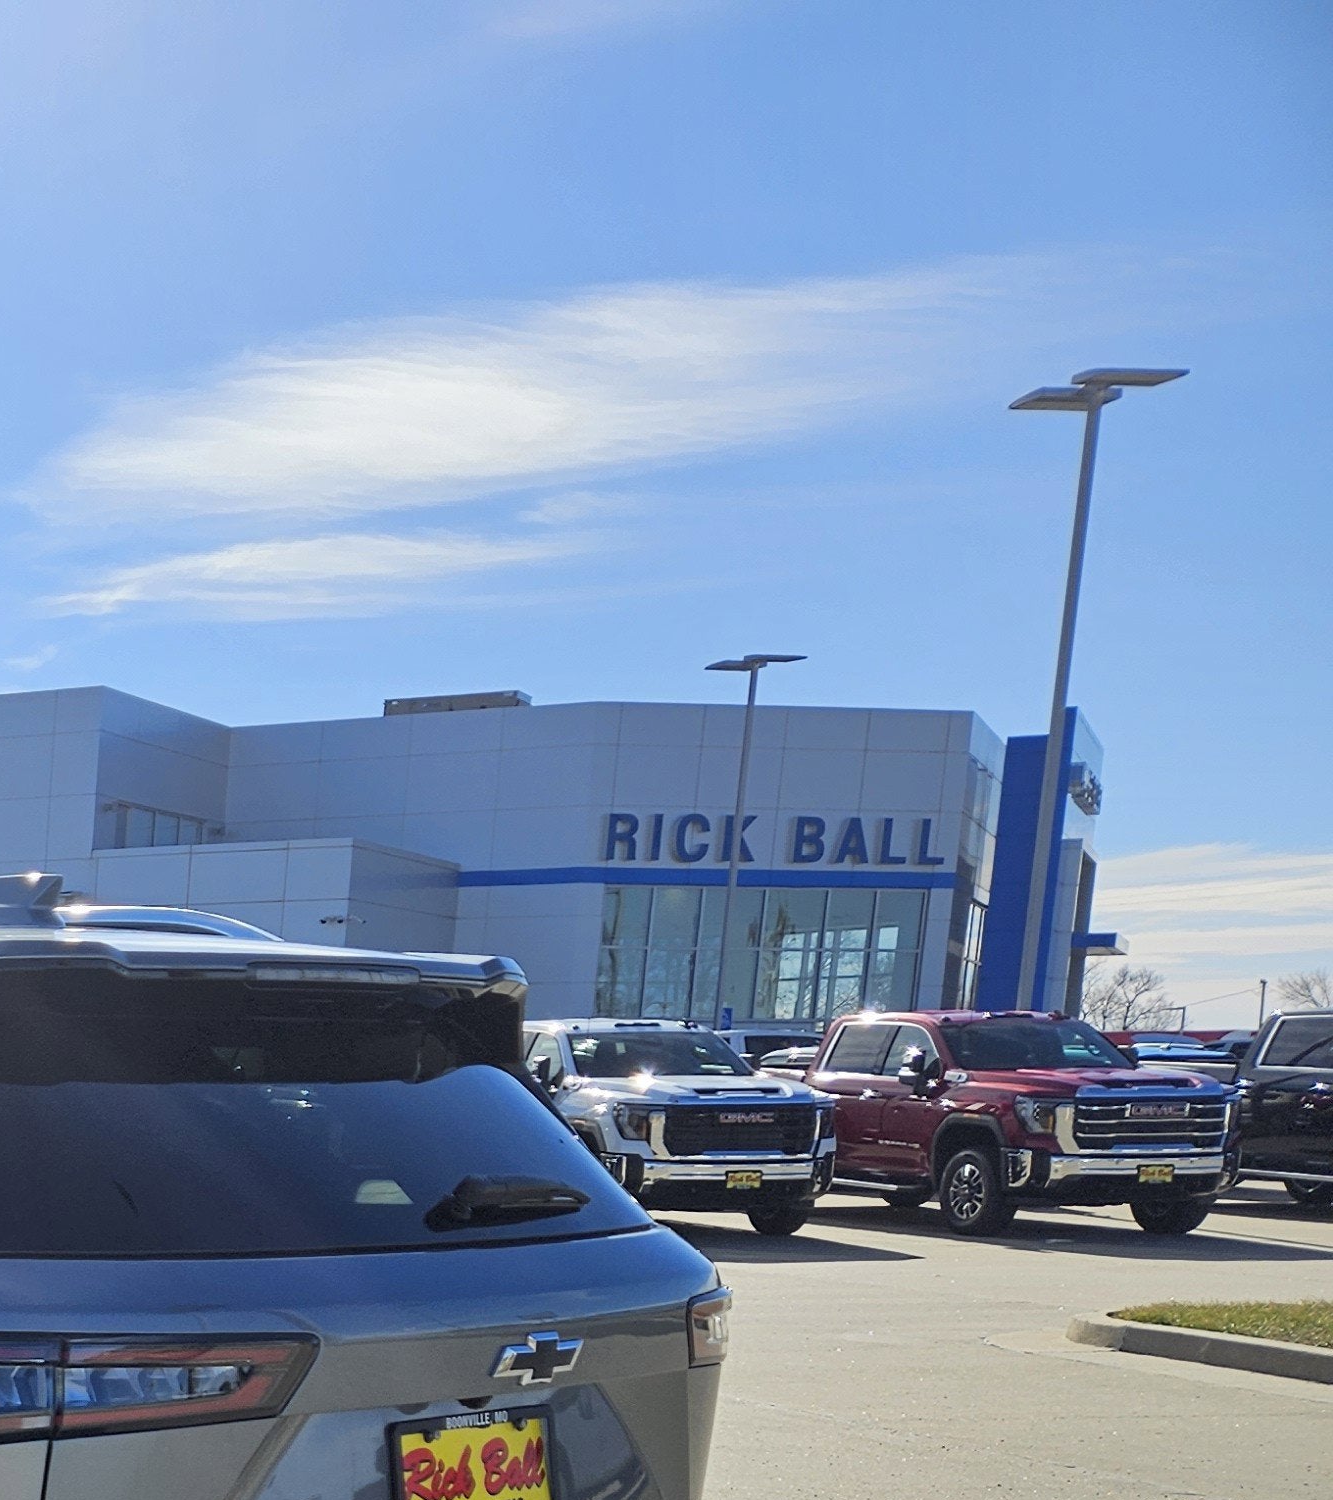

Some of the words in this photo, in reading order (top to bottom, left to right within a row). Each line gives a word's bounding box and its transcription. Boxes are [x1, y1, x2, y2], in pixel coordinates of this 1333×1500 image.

[605, 812, 758, 863] RICK
[792, 815, 945, 865] BALL
[719, 1112, 775, 1123] GMC
[1131, 1104, 1185, 1116] GMC
[446, 1412, 493, 1430] BOONVILLE,
[494, 1410, 508, 1424] MO
[481, 1436, 546, 1496] Ball
